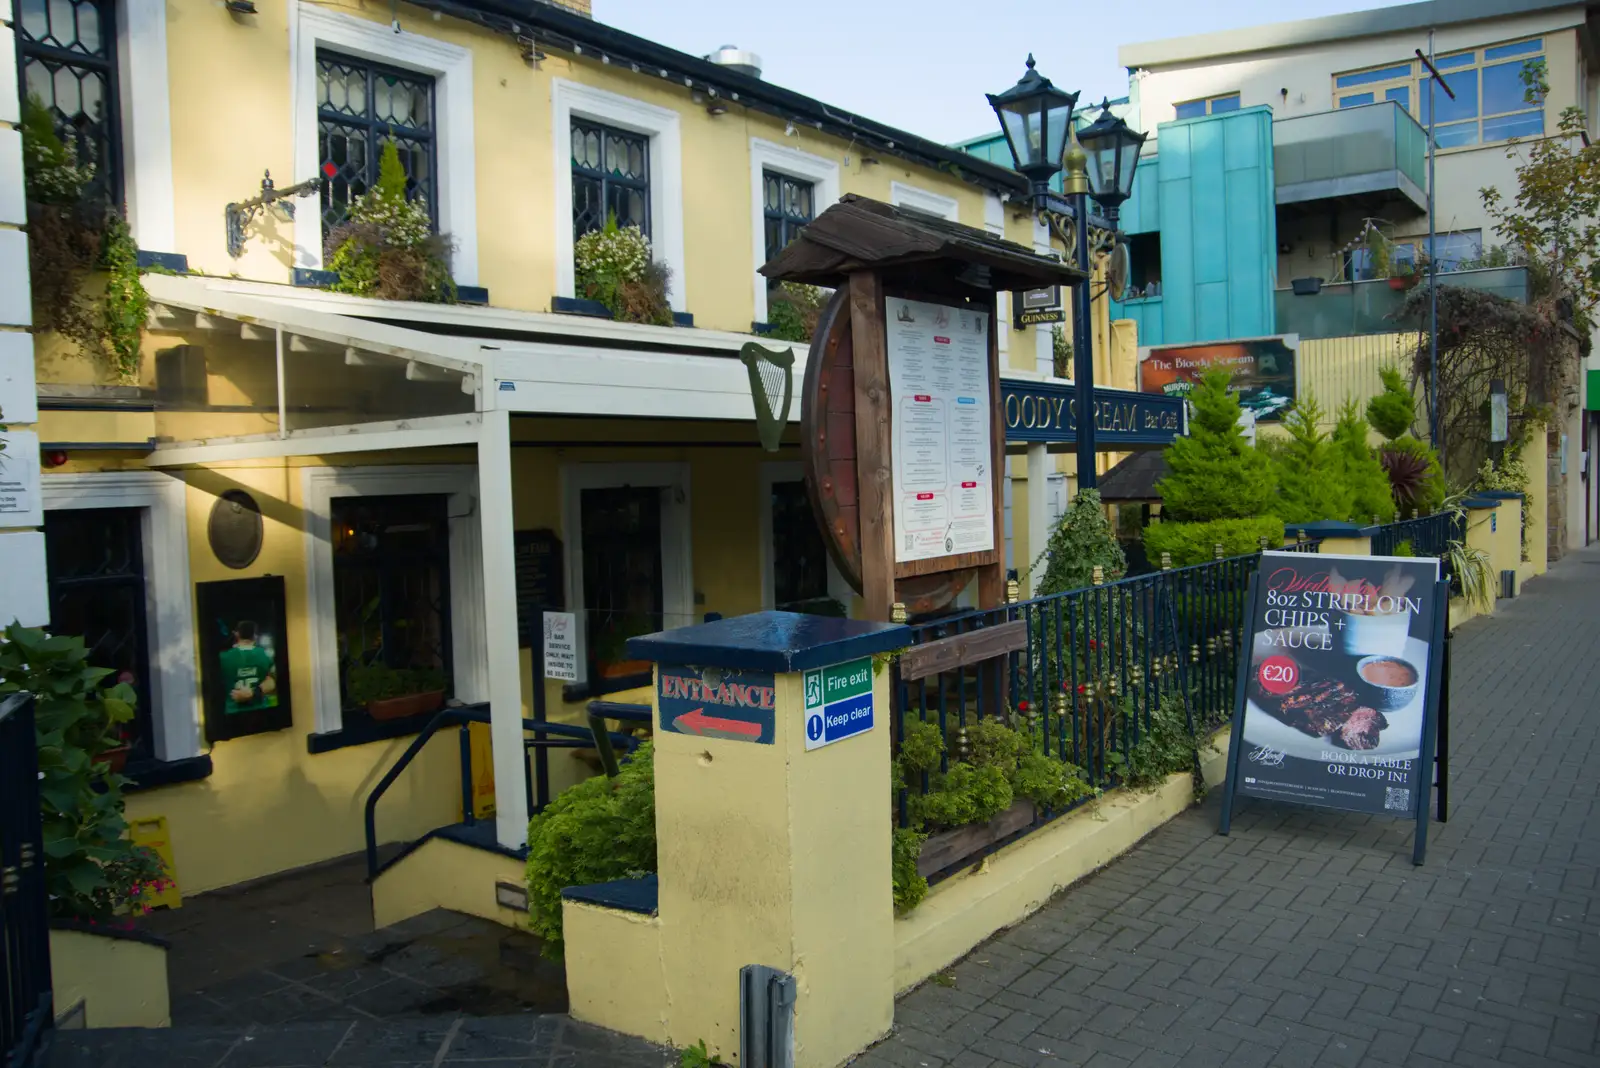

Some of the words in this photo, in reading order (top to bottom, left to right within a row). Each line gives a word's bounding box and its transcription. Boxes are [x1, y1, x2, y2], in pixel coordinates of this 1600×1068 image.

[1021, 313, 1058, 323] GUINNESS
[1152, 360, 1172, 370] The
[1175, 357, 1210, 369] Bloody
[1069, 399, 1138, 432] SREAM
[1144, 410, 1158, 428] Bar
[1266, 567, 1382, 597] Wednesday
[1266, 590, 1297, 607] 8oz
[1301, 591, 1422, 615] STRIPLOIN
[1264, 609, 1329, 629] CHIPS
[1334, 619, 1346, 631] +
[1263, 629, 1333, 651] SAUCE
[827, 675, 847, 692] Fire
[850, 671, 869, 686] exit
[1263, 665, 1293, 682] €20
[826, 713, 849, 728] Keep
[850, 705, 871, 721] clear
[1321, 750, 1357, 764] BOOK
[1358, 756, 1369, 765] A
[1372, 756, 1412, 771] TABLE
[1328, 764, 1346, 776] OR
[1349, 766, 1385, 780] DROP
[1387, 771, 1408, 783] IN!
